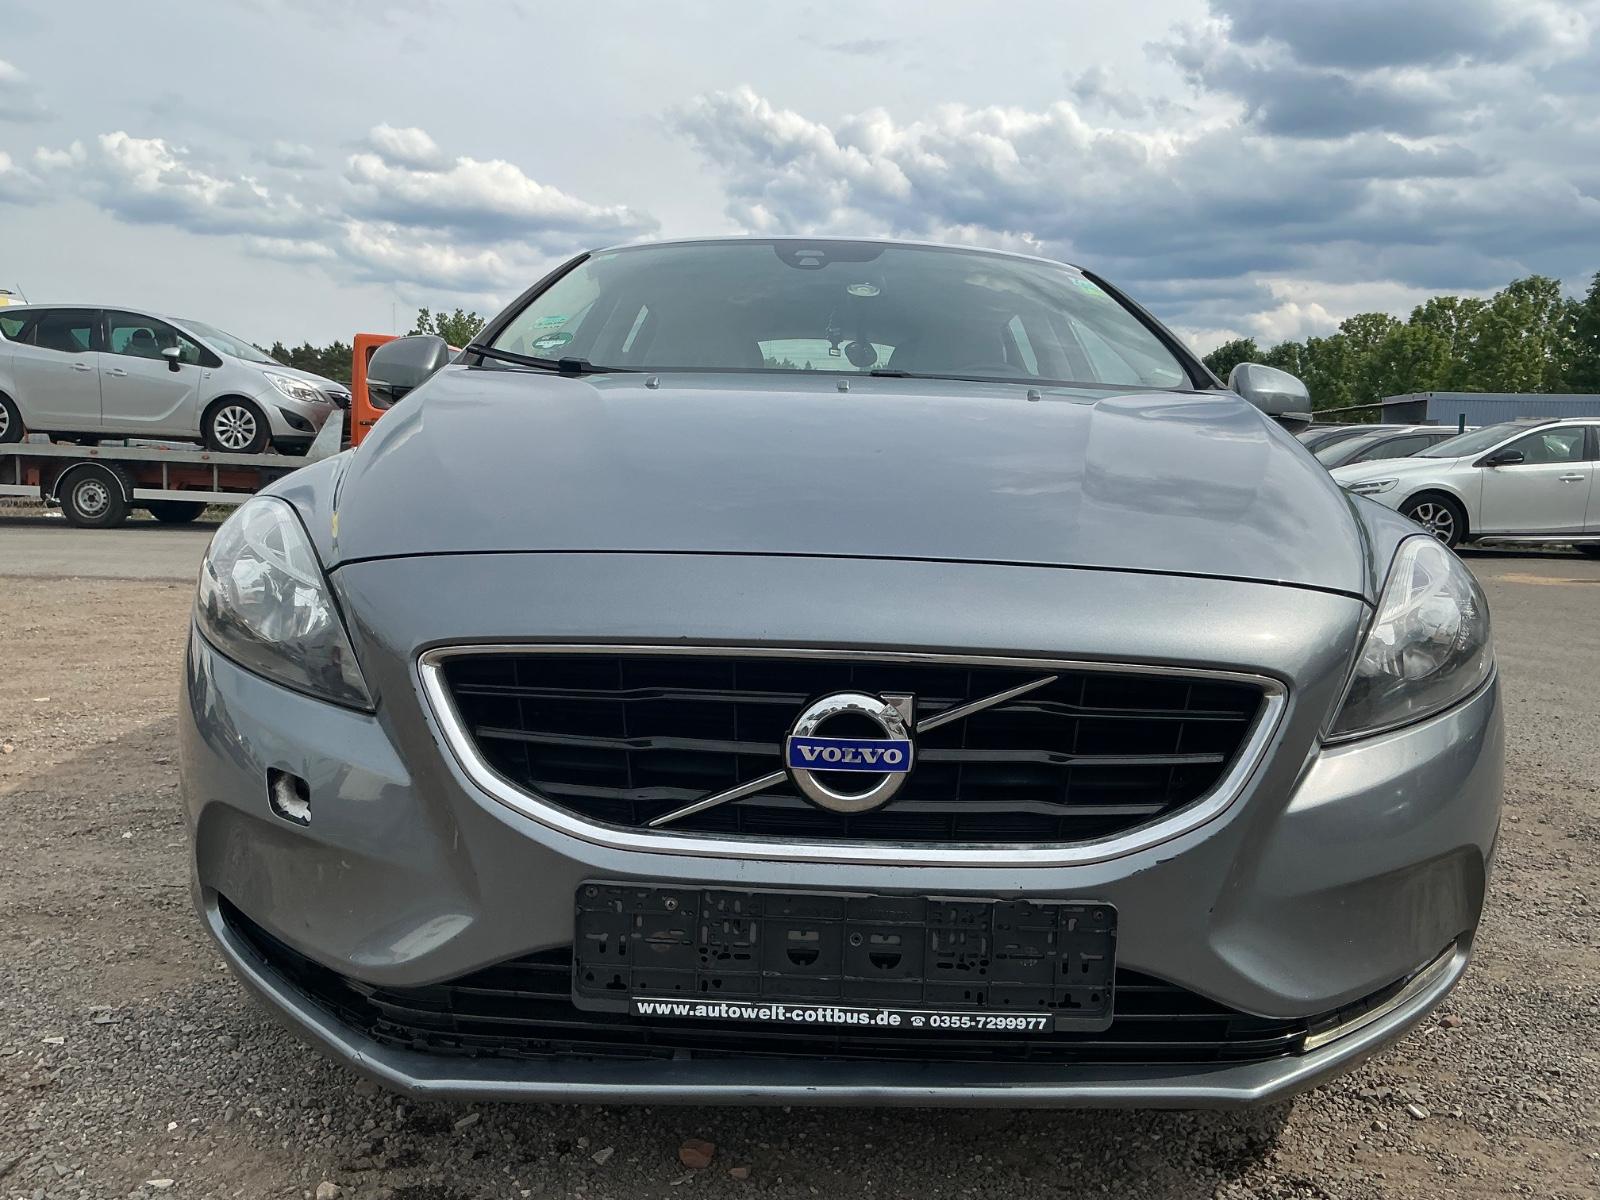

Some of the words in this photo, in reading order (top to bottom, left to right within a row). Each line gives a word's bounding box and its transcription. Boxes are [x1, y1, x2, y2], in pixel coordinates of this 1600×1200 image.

[797, 745, 903, 764] VOLVO
[636, 1002, 901, 1026] www.autowelt-cottbus.de
[929, 1015, 1047, 1030] 0355-7299977
